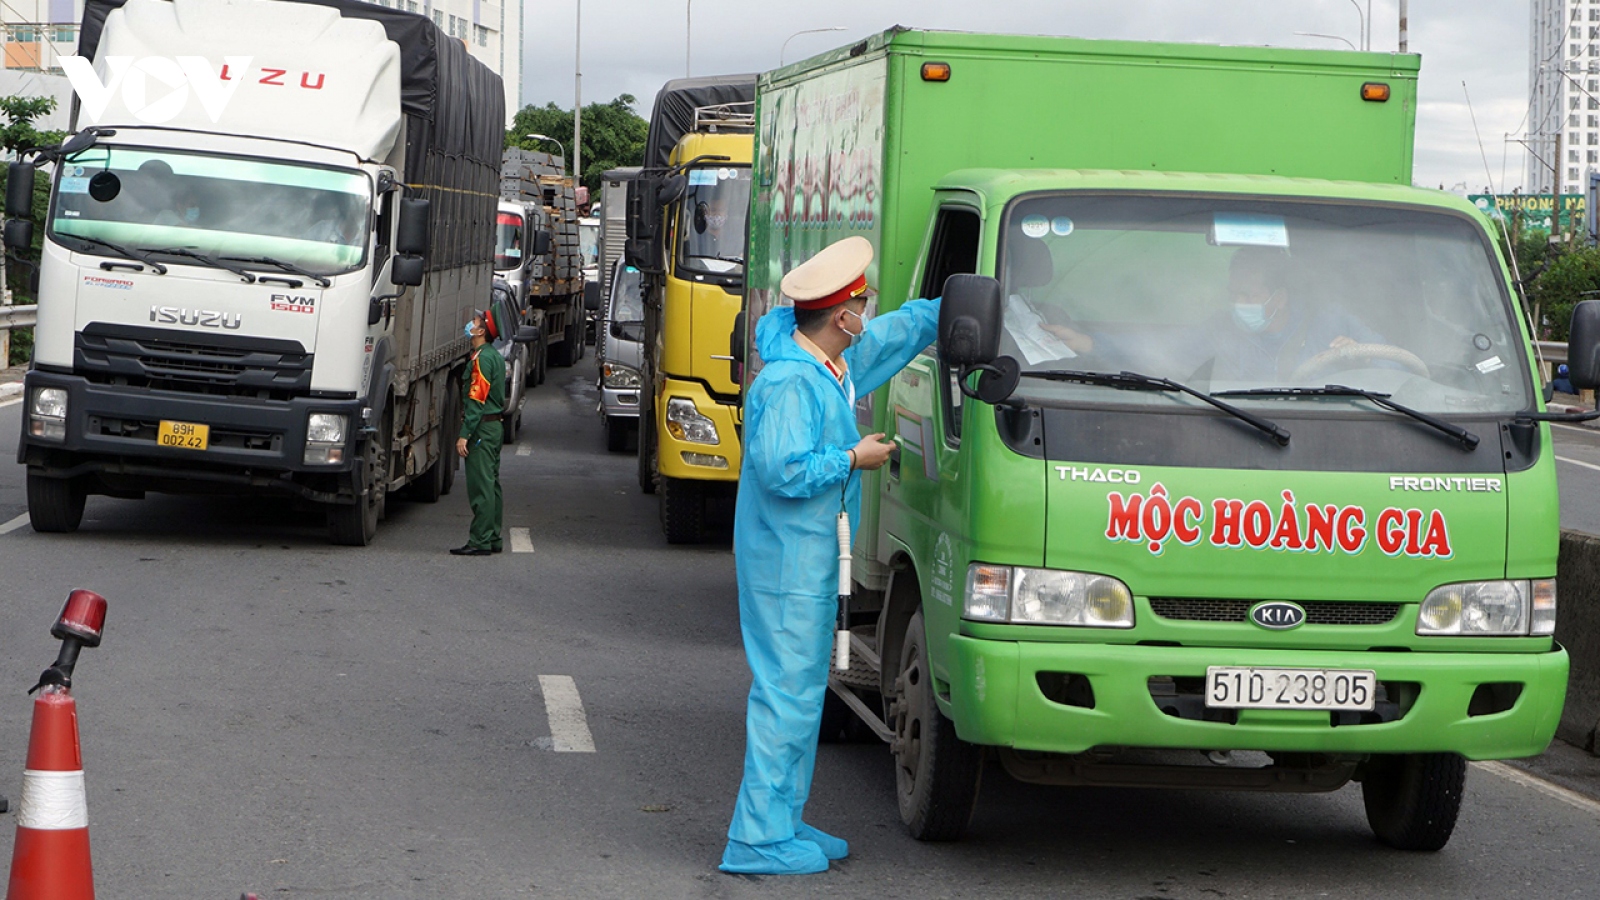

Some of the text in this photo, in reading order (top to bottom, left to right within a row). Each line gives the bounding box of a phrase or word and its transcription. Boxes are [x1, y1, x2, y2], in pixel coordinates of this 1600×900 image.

[270, 294, 315, 306] FVM
[270, 303, 314, 314] 1500
[149, 305, 242, 330] ISUZU
[173, 424, 195, 435] 89H
[163, 434, 202, 448] 002.42
[1055, 466, 1141, 484] THACO
[1389, 476, 1502, 493] FRONTIER
[1105, 482, 1453, 559] MỘC HOÀNG GIA
[1262, 608, 1296, 622] KIA
